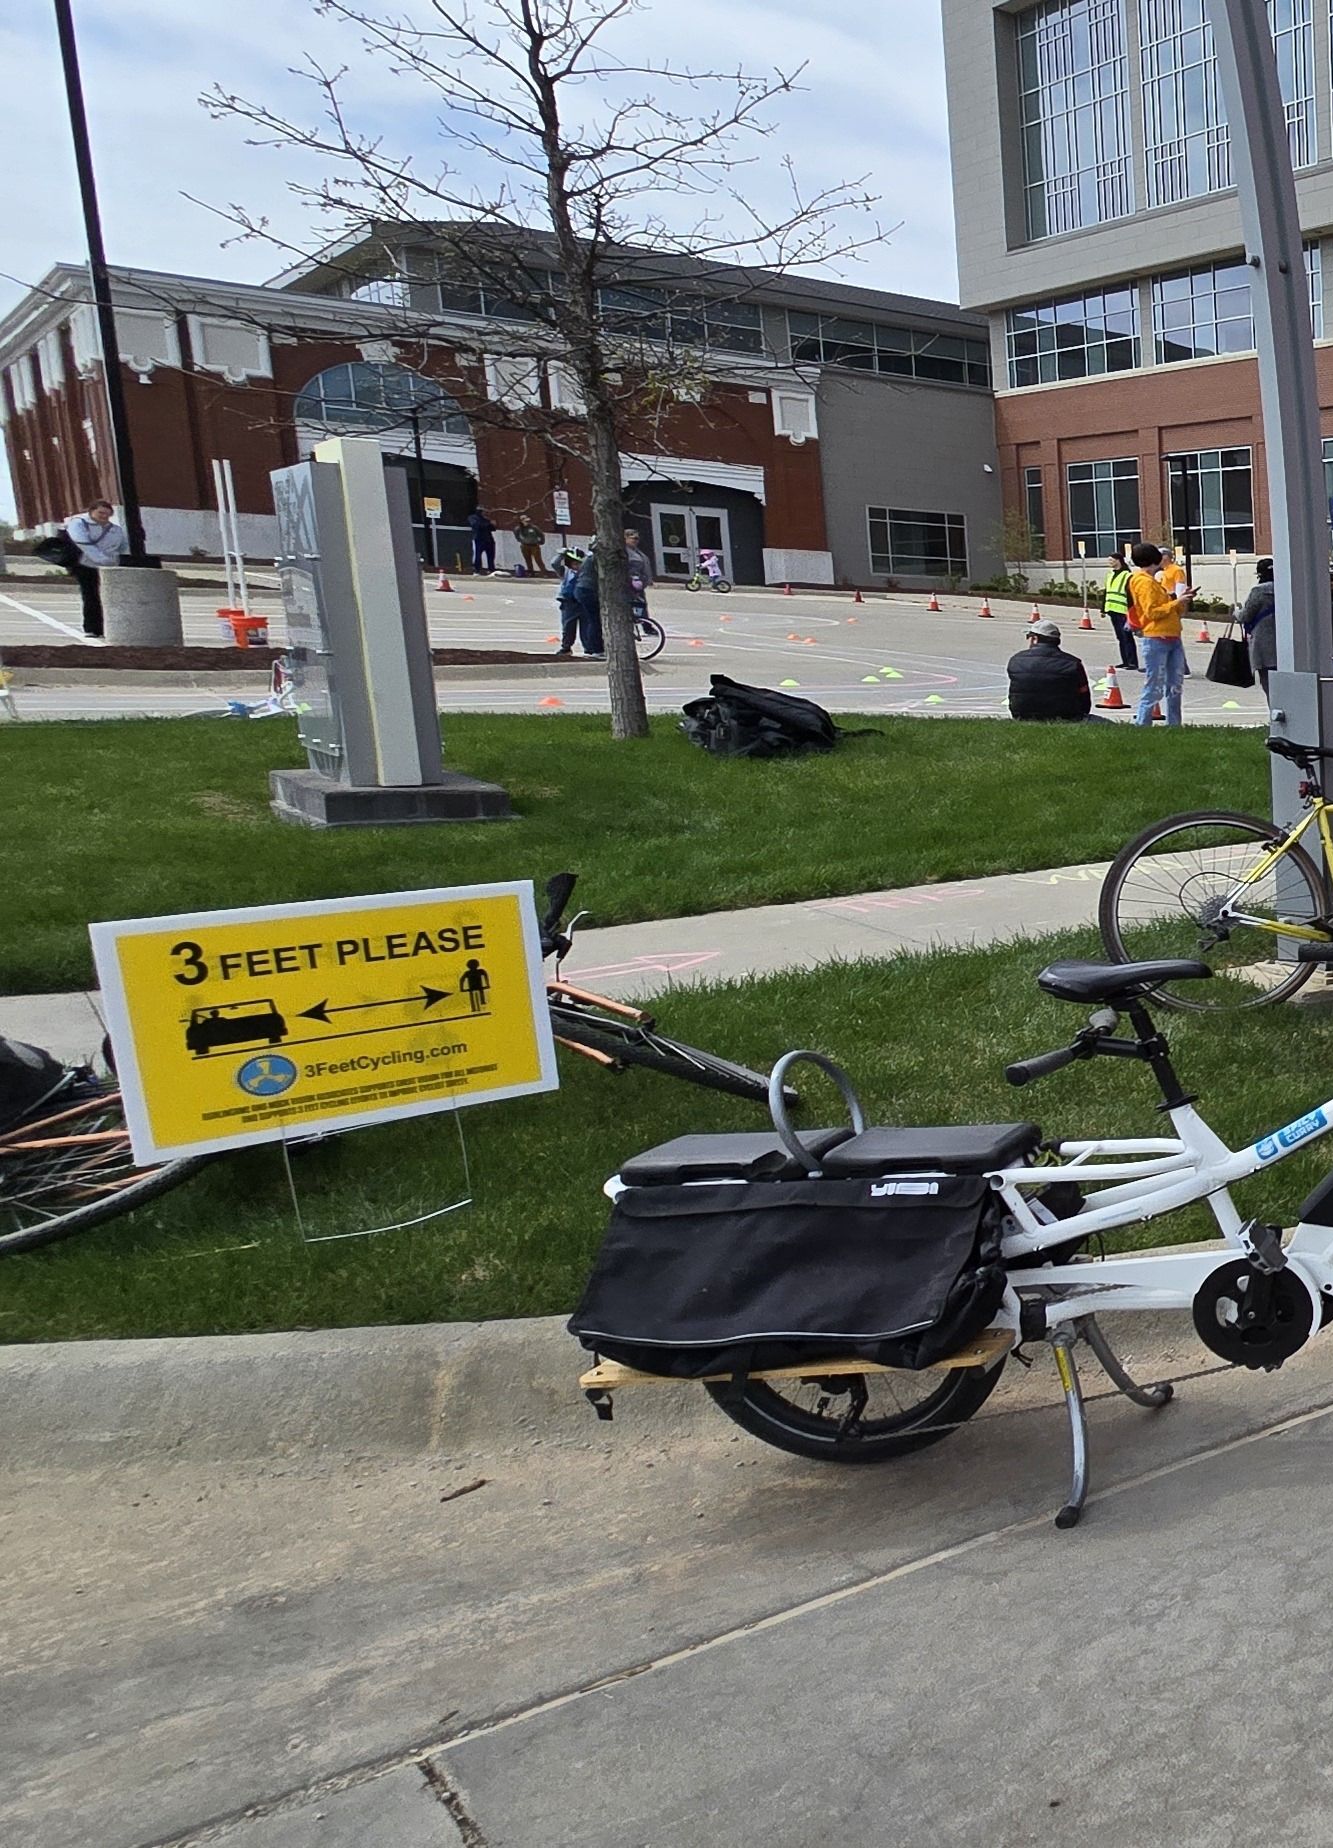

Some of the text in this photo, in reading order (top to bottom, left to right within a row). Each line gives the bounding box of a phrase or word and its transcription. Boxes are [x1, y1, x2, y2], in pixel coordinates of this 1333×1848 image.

[170, 925, 486, 986] 3 FEET PLEASE
[304, 1042, 468, 1078] 3FeetCycling.com
